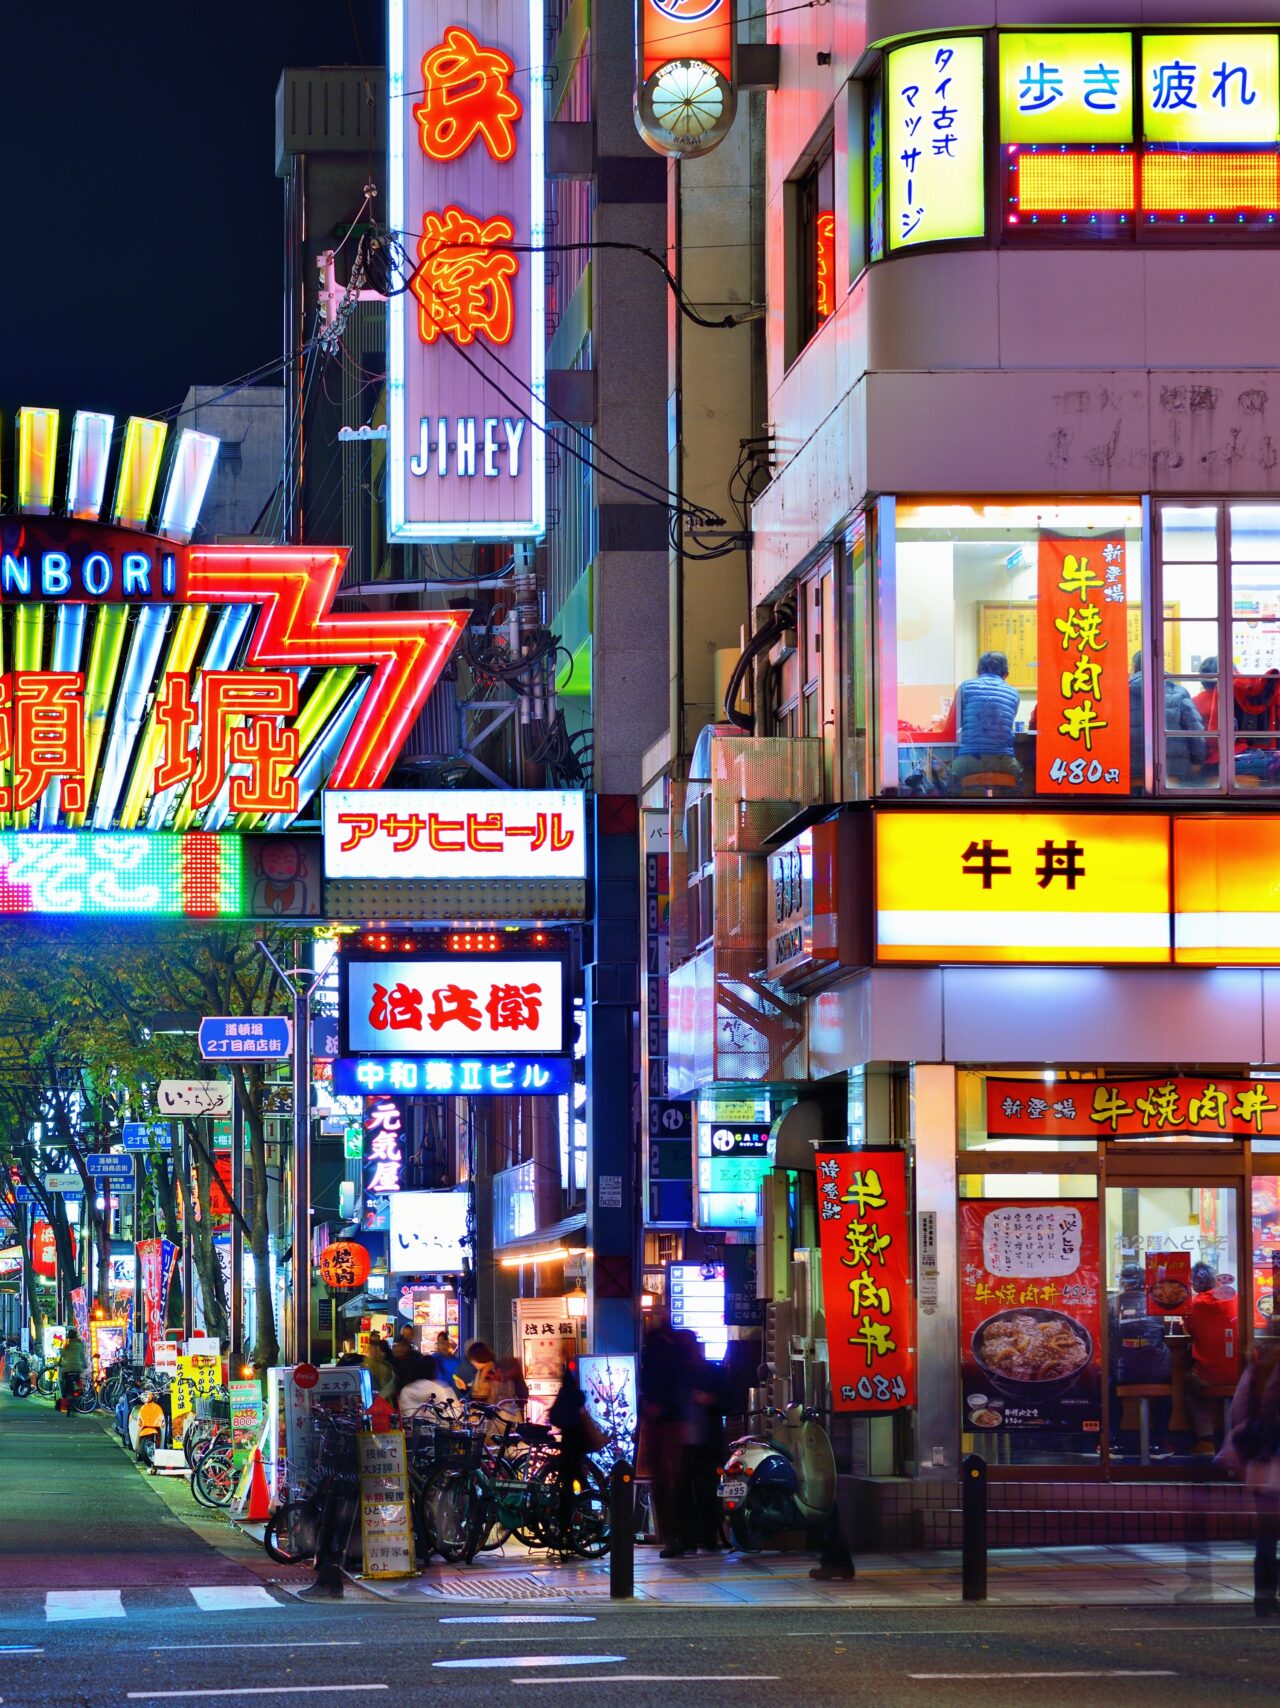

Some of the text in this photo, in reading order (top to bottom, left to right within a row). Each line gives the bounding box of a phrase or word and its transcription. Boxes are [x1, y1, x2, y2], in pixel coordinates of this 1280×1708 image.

[655, 60, 720, 79] FRUITS TOWER
[1020, 61, 1256, 111] 歩き疲れ
[931, 48, 958, 157] タイ古式
[900, 85, 924, 238] マッサージ
[410, 417, 525, 477] JIHEY
[1101, 543, 1125, 604] 新登場
[1054, 553, 1108, 750] 牛焼肉丼
[1049, 757, 1120, 785] 480円
[338, 811, 575, 853] アサヒビール
[961, 839, 1086, 890] 牛丼
[225, 1023, 263, 1036] 道頓堀
[368, 982, 543, 1032] 治兵衛
[207, 1040, 281, 1052] 2丁目商店街
[1001, 1081, 1278, 1132] 新登場 牛焼肉丼
[367, 1103, 402, 1192] 元気屋
[734, 1133, 769, 1142] GARO
[366, 1212, 386, 1227] 2F
[332, 1249, 356, 1285] 焼肉
[322, 1381, 351, 1391] エステ
